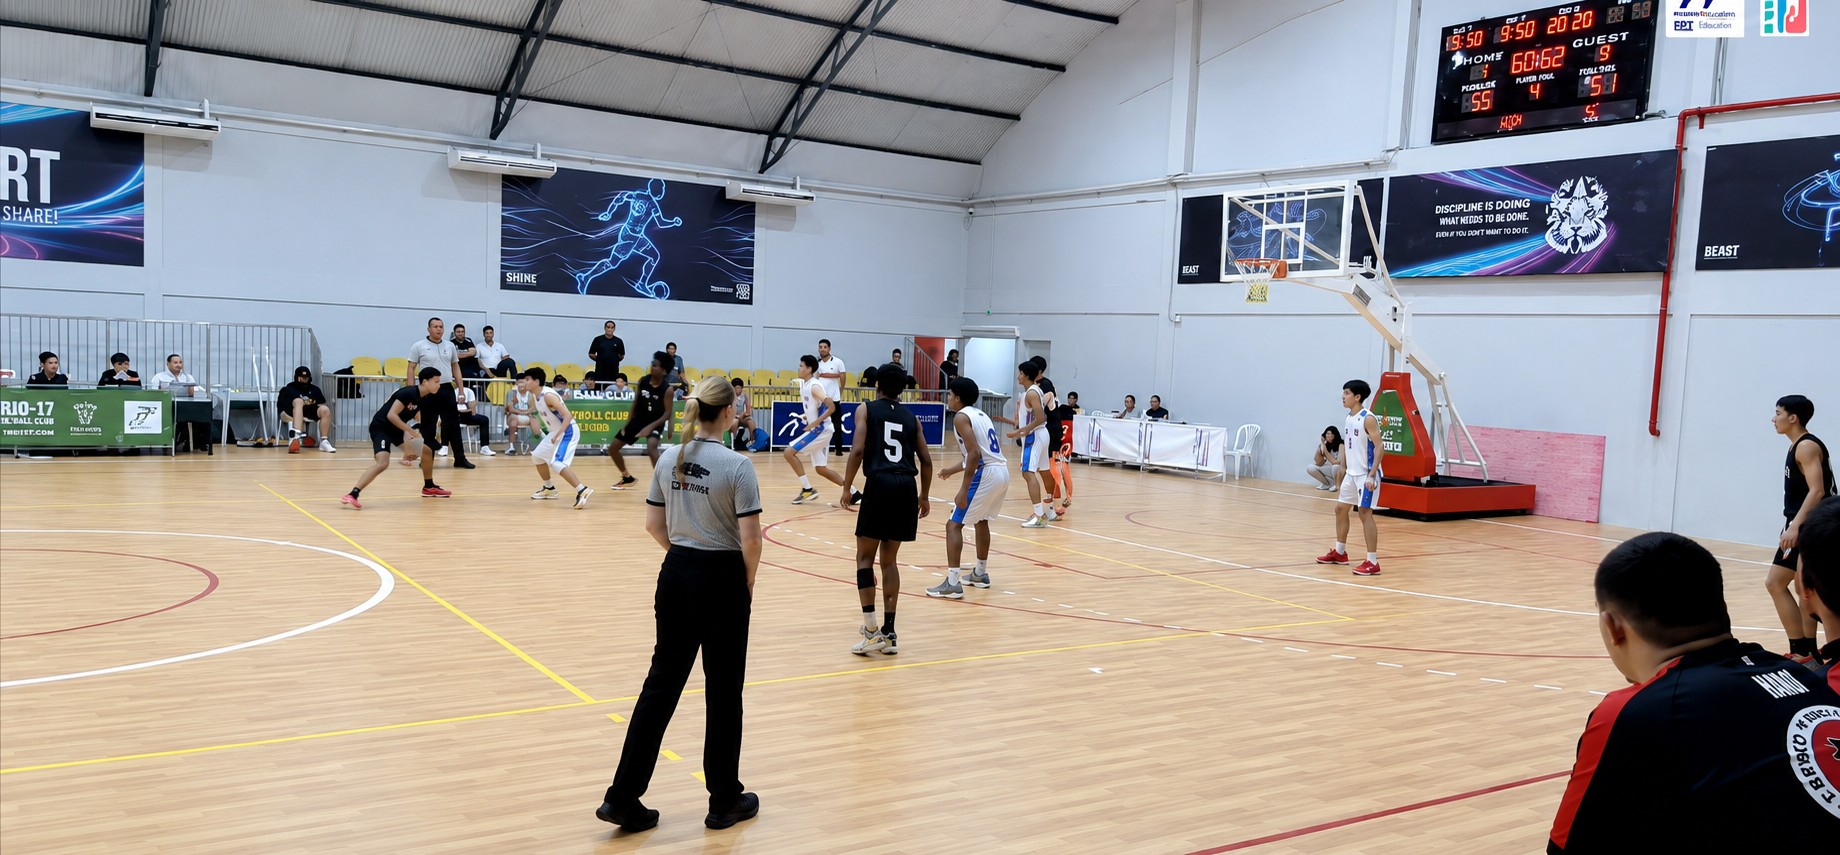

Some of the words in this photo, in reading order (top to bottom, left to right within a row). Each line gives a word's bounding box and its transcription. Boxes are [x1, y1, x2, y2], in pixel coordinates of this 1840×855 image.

[1572, 31, 1629, 48] GUEST
[2, 205, 58, 225] SHARE!
[1435, 202, 1484, 215] DISCIPLINE
[1485, 201, 1493, 211] IS
[1495, 198, 1531, 211] DOING
[1440, 216, 1459, 226] WHAT
[1485, 214, 1494, 223] TO
[1495, 213, 1505, 223] BE
[1507, 211, 1530, 222] DONE.
[1704, 244, 1740, 258] BEAST
[506, 271, 537, 284] SHINE
[884, 421, 903, 463] 5
